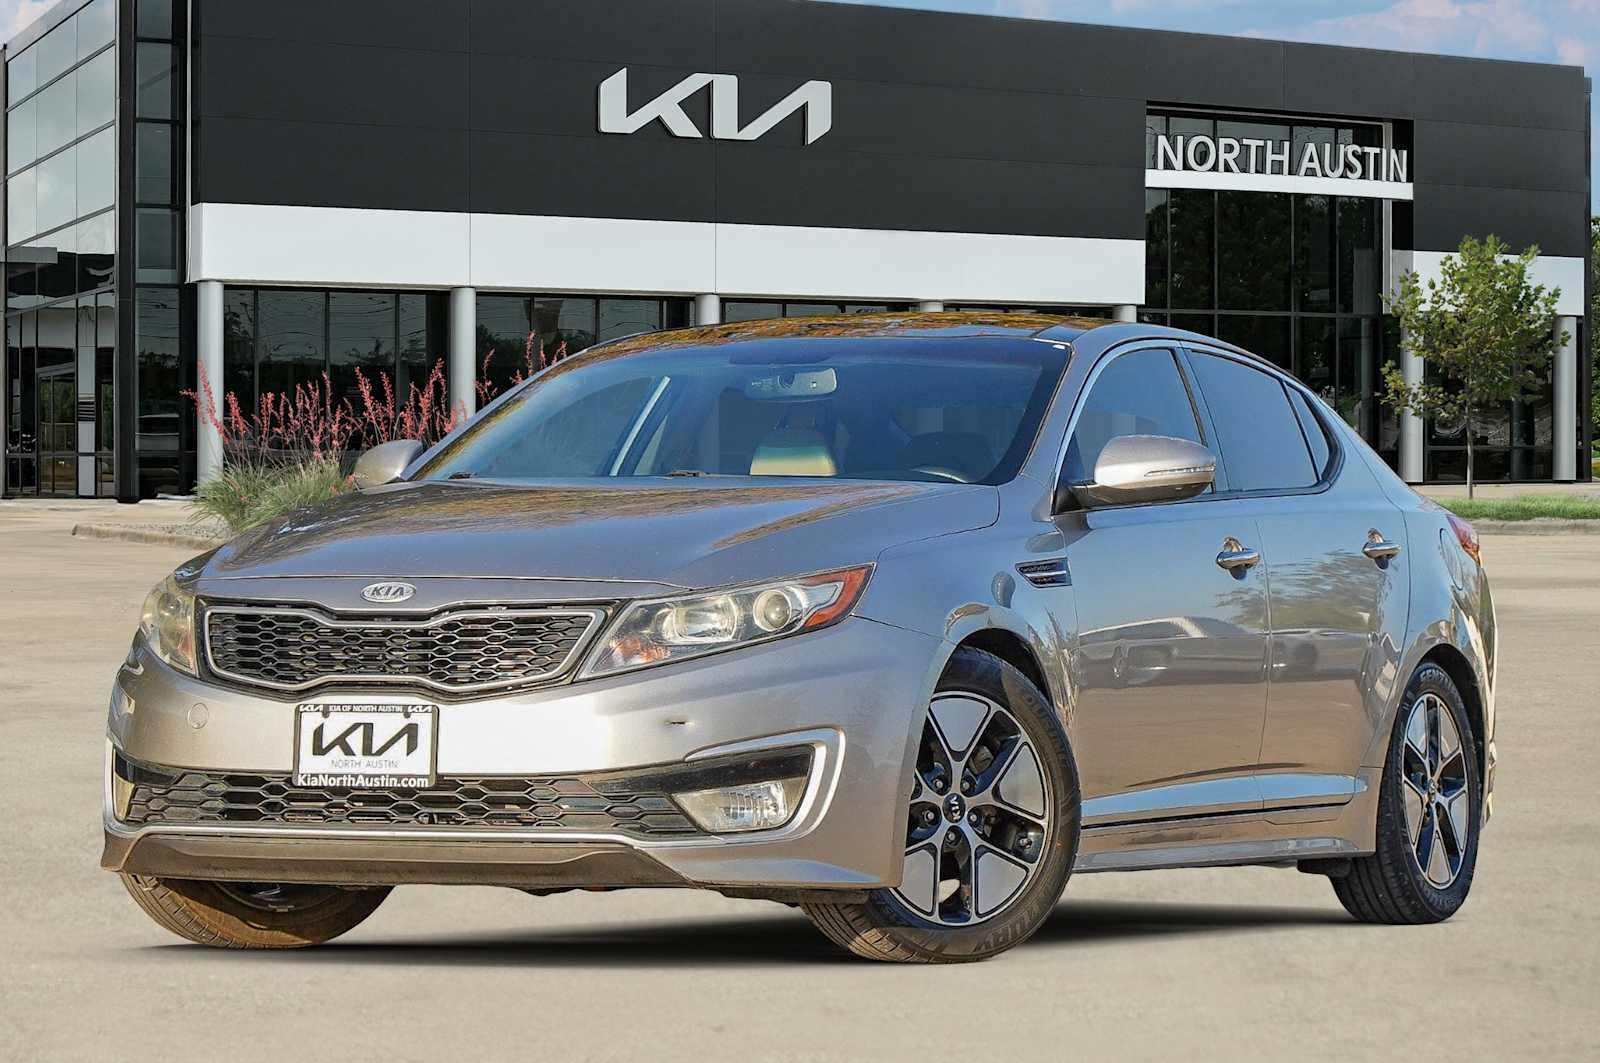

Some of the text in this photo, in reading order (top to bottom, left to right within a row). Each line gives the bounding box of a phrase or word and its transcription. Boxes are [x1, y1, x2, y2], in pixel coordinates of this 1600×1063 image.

[599, 67, 831, 145] KIA
[1157, 134, 1407, 182] NORTH AUSTIN
[371, 586, 405, 596] KIA
[312, 722, 418, 757] KIA
[331, 760, 398, 769] NORTH AUSTIN
[297, 775, 428, 787] KiaNorthAustin.com
